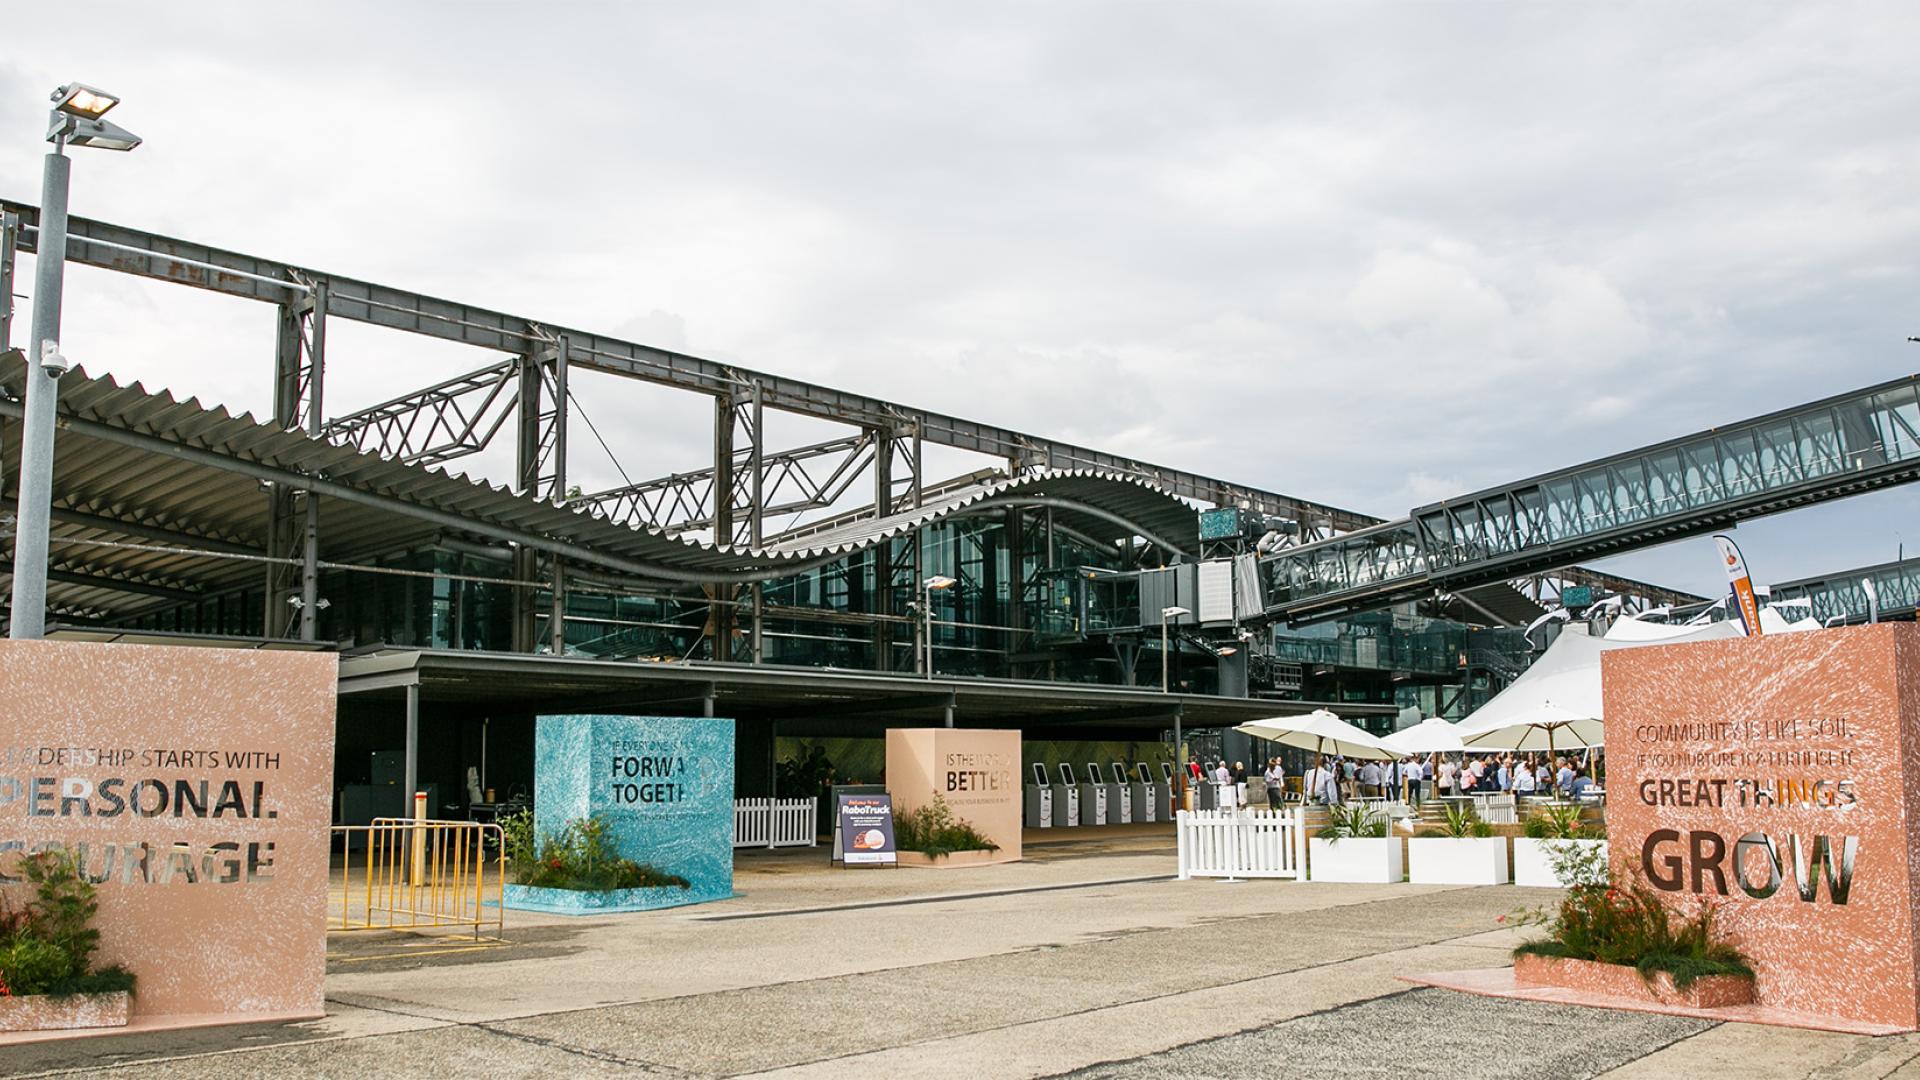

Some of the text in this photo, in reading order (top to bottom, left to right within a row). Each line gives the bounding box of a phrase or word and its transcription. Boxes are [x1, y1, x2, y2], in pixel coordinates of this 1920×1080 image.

[1636, 722, 1739, 743] COMMUNITY
[1745, 720, 1760, 740] IS
[1765, 719, 1803, 740] LIKE
[142, 749, 219, 769] STARTS
[226, 751, 281, 770] WITH
[946, 754, 955, 766] IS
[956, 754, 974, 766] THE
[946, 770, 1010, 792] BETTER
[0, 776, 279, 819] PERSONAL
[1640, 778, 1857, 811] GREAT THINGS
[842, 805, 890, 814] RaboTruck
[1641, 828, 1858, 905] GROW
